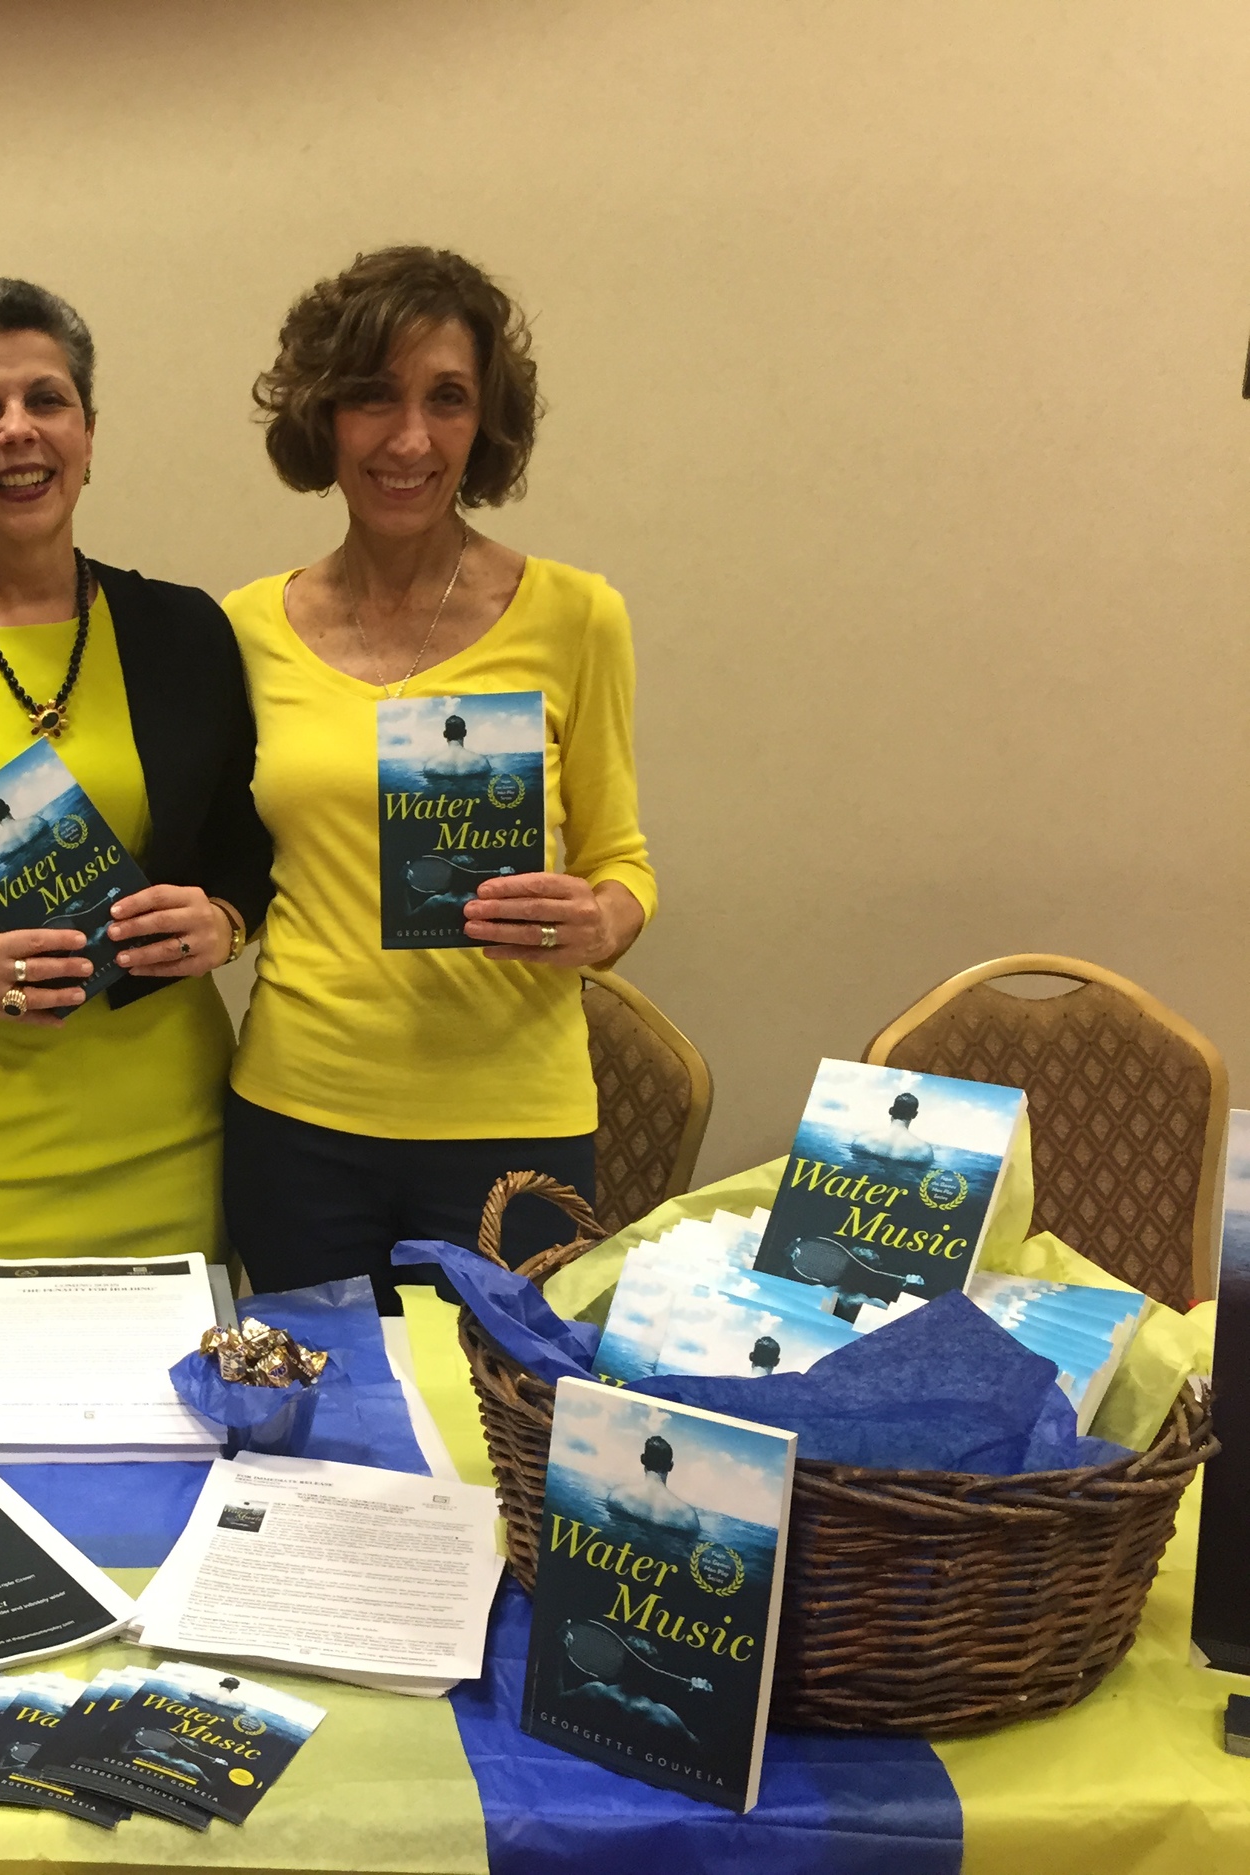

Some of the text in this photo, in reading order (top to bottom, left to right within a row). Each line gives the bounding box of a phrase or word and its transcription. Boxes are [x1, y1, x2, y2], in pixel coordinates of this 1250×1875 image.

[385, 792, 480, 820] Water
[433, 819, 537, 850] Music
[37, 844, 121, 915] Music
[397, 928, 464, 937] GEORGETT
[790, 1158, 909, 1208] Water
[833, 1207, 968, 1260] Music
[551, 1513, 678, 1588] Water
[603, 1583, 754, 1662] Music
[142, 1693, 226, 1726] Water
[170, 1719, 262, 1760] Music
[540, 1711, 725, 1787] GEORGETTE GOUVEIA
[47, 1790, 97, 1812] GOUVEIA
[70, 1763, 132, 1786] GEORGETTE
[138, 1784, 187, 1807] GOUVEIA
[103, 1757, 165, 1781] GEORGETTE
[170, 1779, 219, 1803] GOUVEIA
